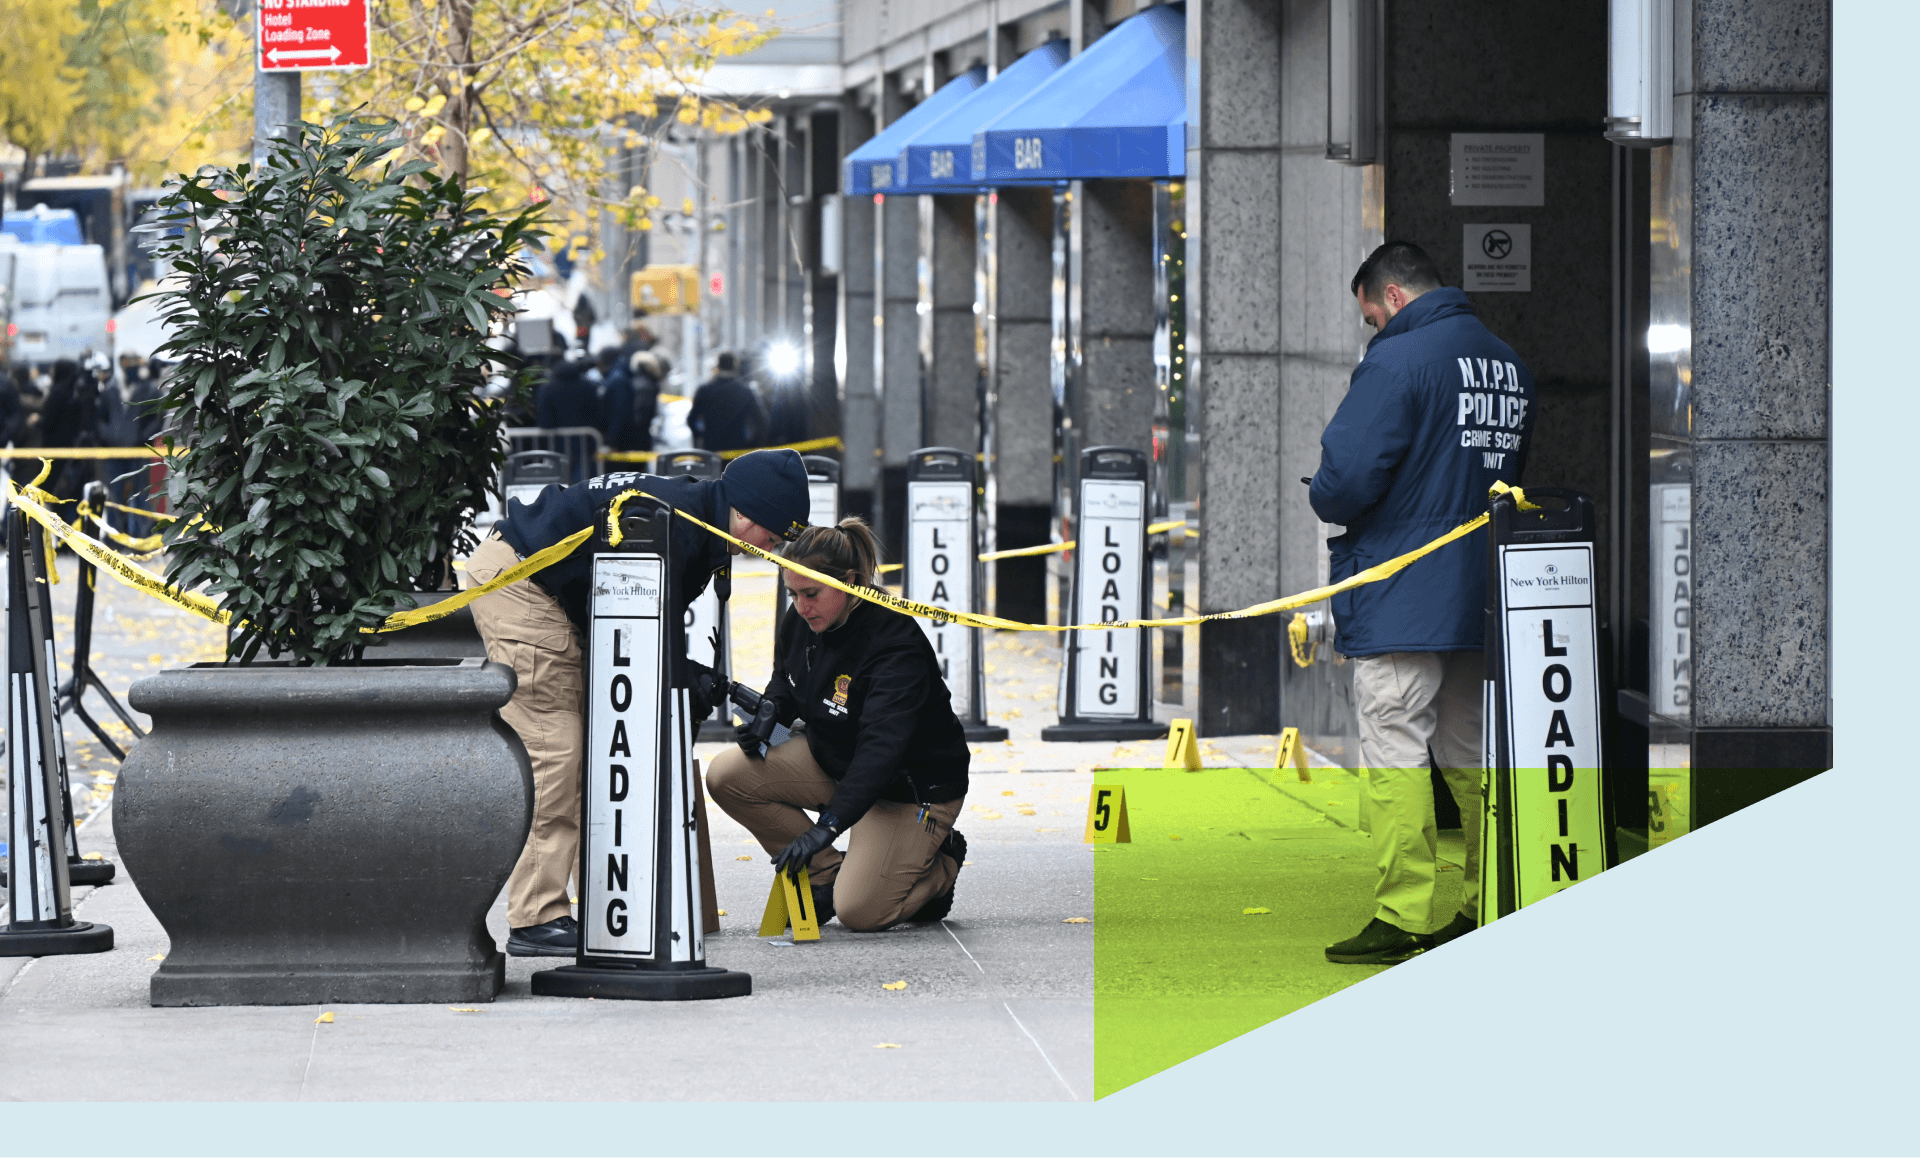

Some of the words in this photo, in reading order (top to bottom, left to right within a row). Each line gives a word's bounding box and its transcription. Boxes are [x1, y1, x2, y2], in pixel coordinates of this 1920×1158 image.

[265, 12, 292, 26] Hotel
[265, 28, 304, 43] Loading
[306, 27, 331, 40] Zone
[930, 150, 954, 178] BAR
[1015, 138, 1042, 169] BAR
[1464, 144, 1492, 152] PRIVATE
[1495, 144, 1531, 152] PROPERTY
[1457, 357, 1524, 394] N.Y.P.D.
[1457, 392, 1529, 430] POLICE
[1461, 430, 1492, 447] CRIME
[612, 586, 629, 596] York
[630, 586, 657, 596] Hilton
[1510, 578, 1534, 587] New
[1535, 576, 1559, 587] York
[1560, 575, 1589, 585] Hilton
[1099, 526, 1122, 705] LOADING
[1173, 728, 1185, 761] 7
[1279, 734, 1291, 769] 6
[1542, 619, 1579, 892] LOADIN
[605, 629, 632, 938] LOADING
[1094, 790, 1112, 832] 5
[792, 868, 807, 921] 1
